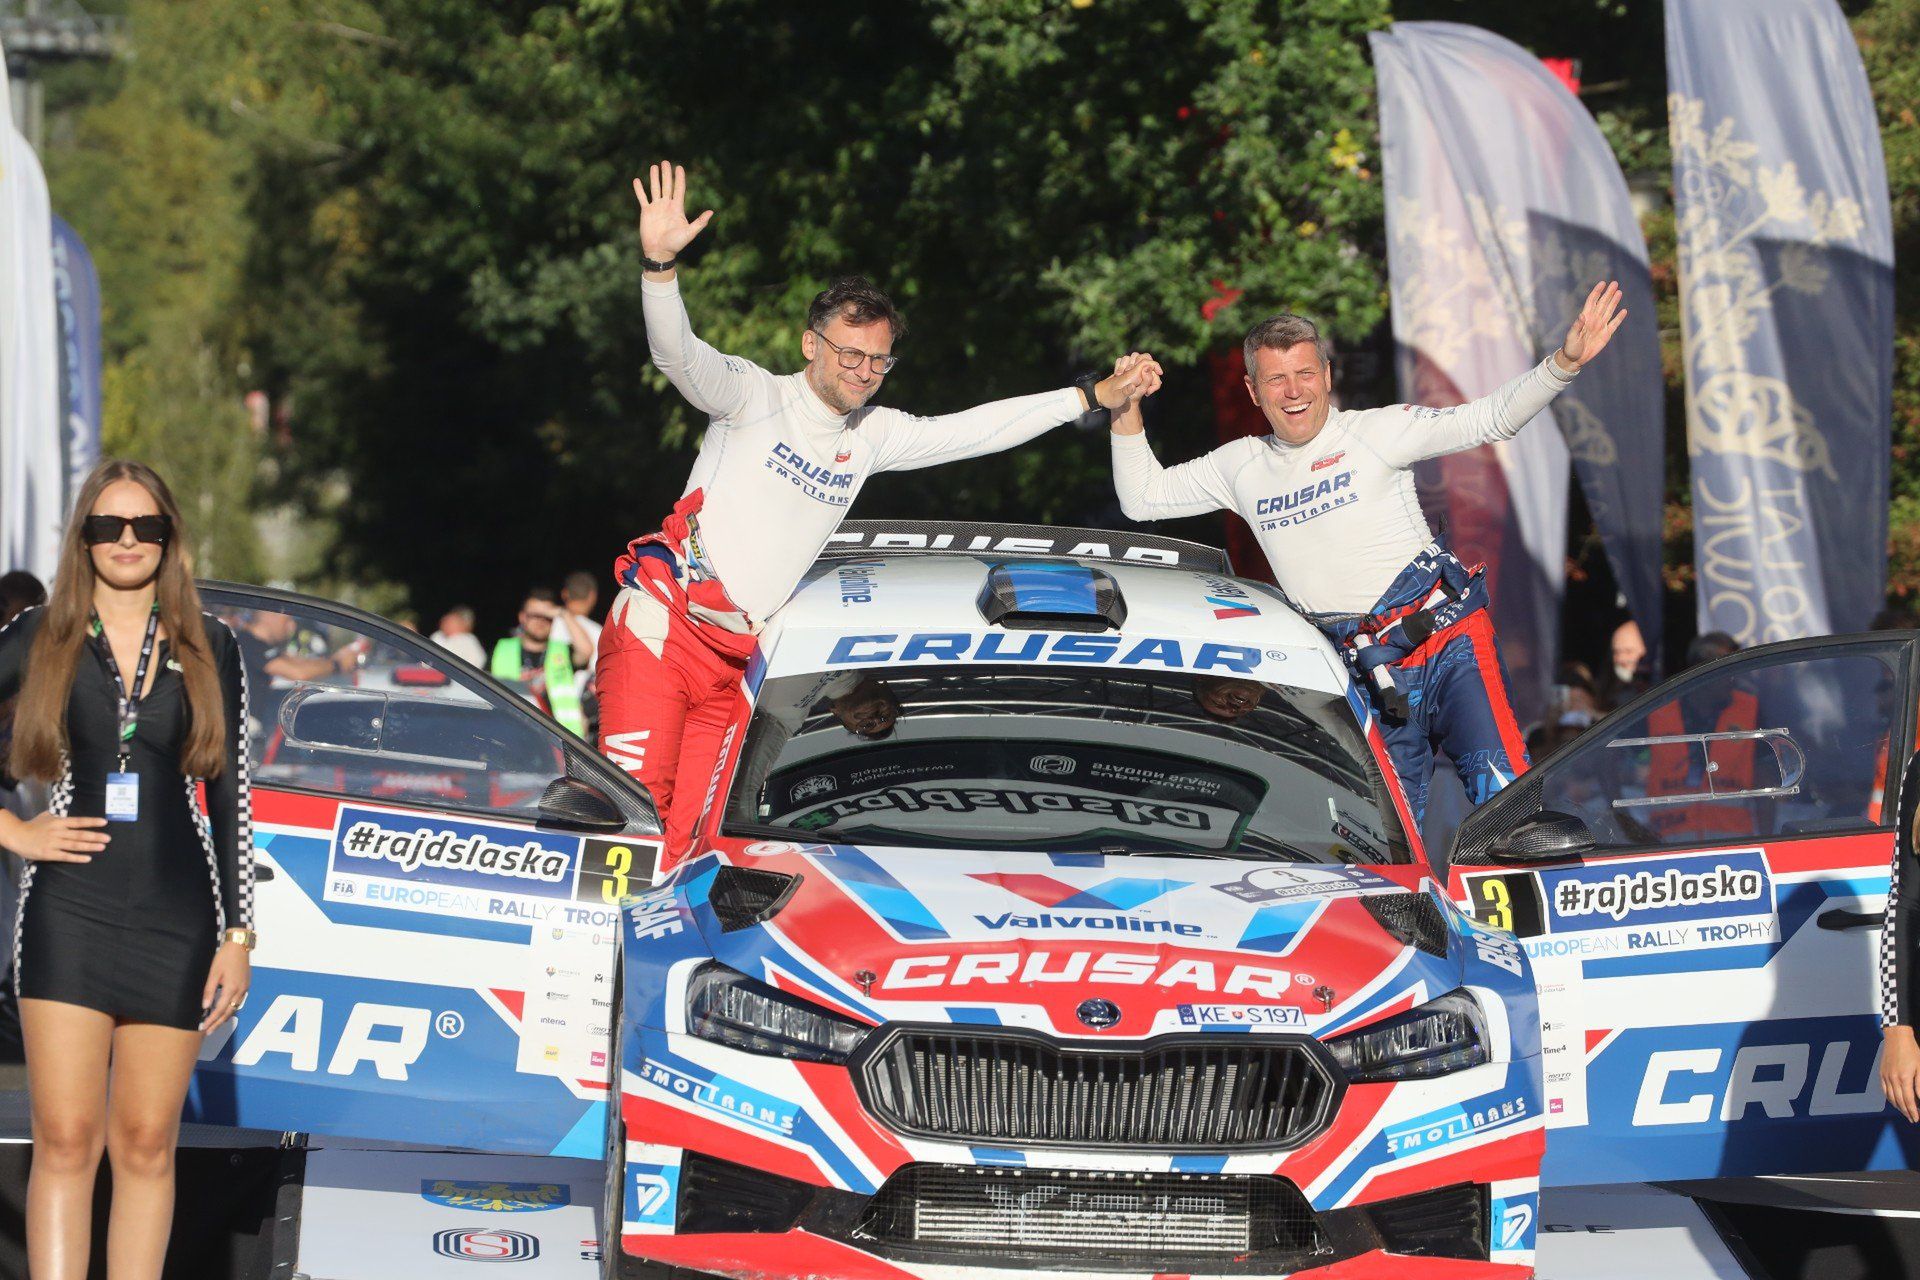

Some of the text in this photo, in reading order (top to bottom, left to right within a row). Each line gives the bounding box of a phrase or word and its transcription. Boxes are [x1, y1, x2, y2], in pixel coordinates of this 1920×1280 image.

[765, 457, 849, 506] SMOLTRANS
[1260, 493, 1359, 531] SMOLTRANS
[349, 826, 565, 877] #rajdslaska
[601, 845, 632, 907] 3
[366, 884, 480, 912] EUROPEAN
[488, 898, 555, 921] RALLY
[564, 907, 619, 927] TROP
[1482, 879, 1513, 932] 3
[1559, 871, 1758, 916] #rajdslaska
[1524, 934, 1618, 960] UROPEAN
[1627, 928, 1690, 949] RALLY
[1696, 920, 1776, 943] TROPHY
[1199, 1007, 1229, 1022] KE
[1247, 1007, 1301, 1024] S197
[640, 1057, 793, 1136] SMOLTRANS
[1632, 1040, 1887, 1127] CRU
[1387, 1096, 1527, 1156] SMOLTRANS
